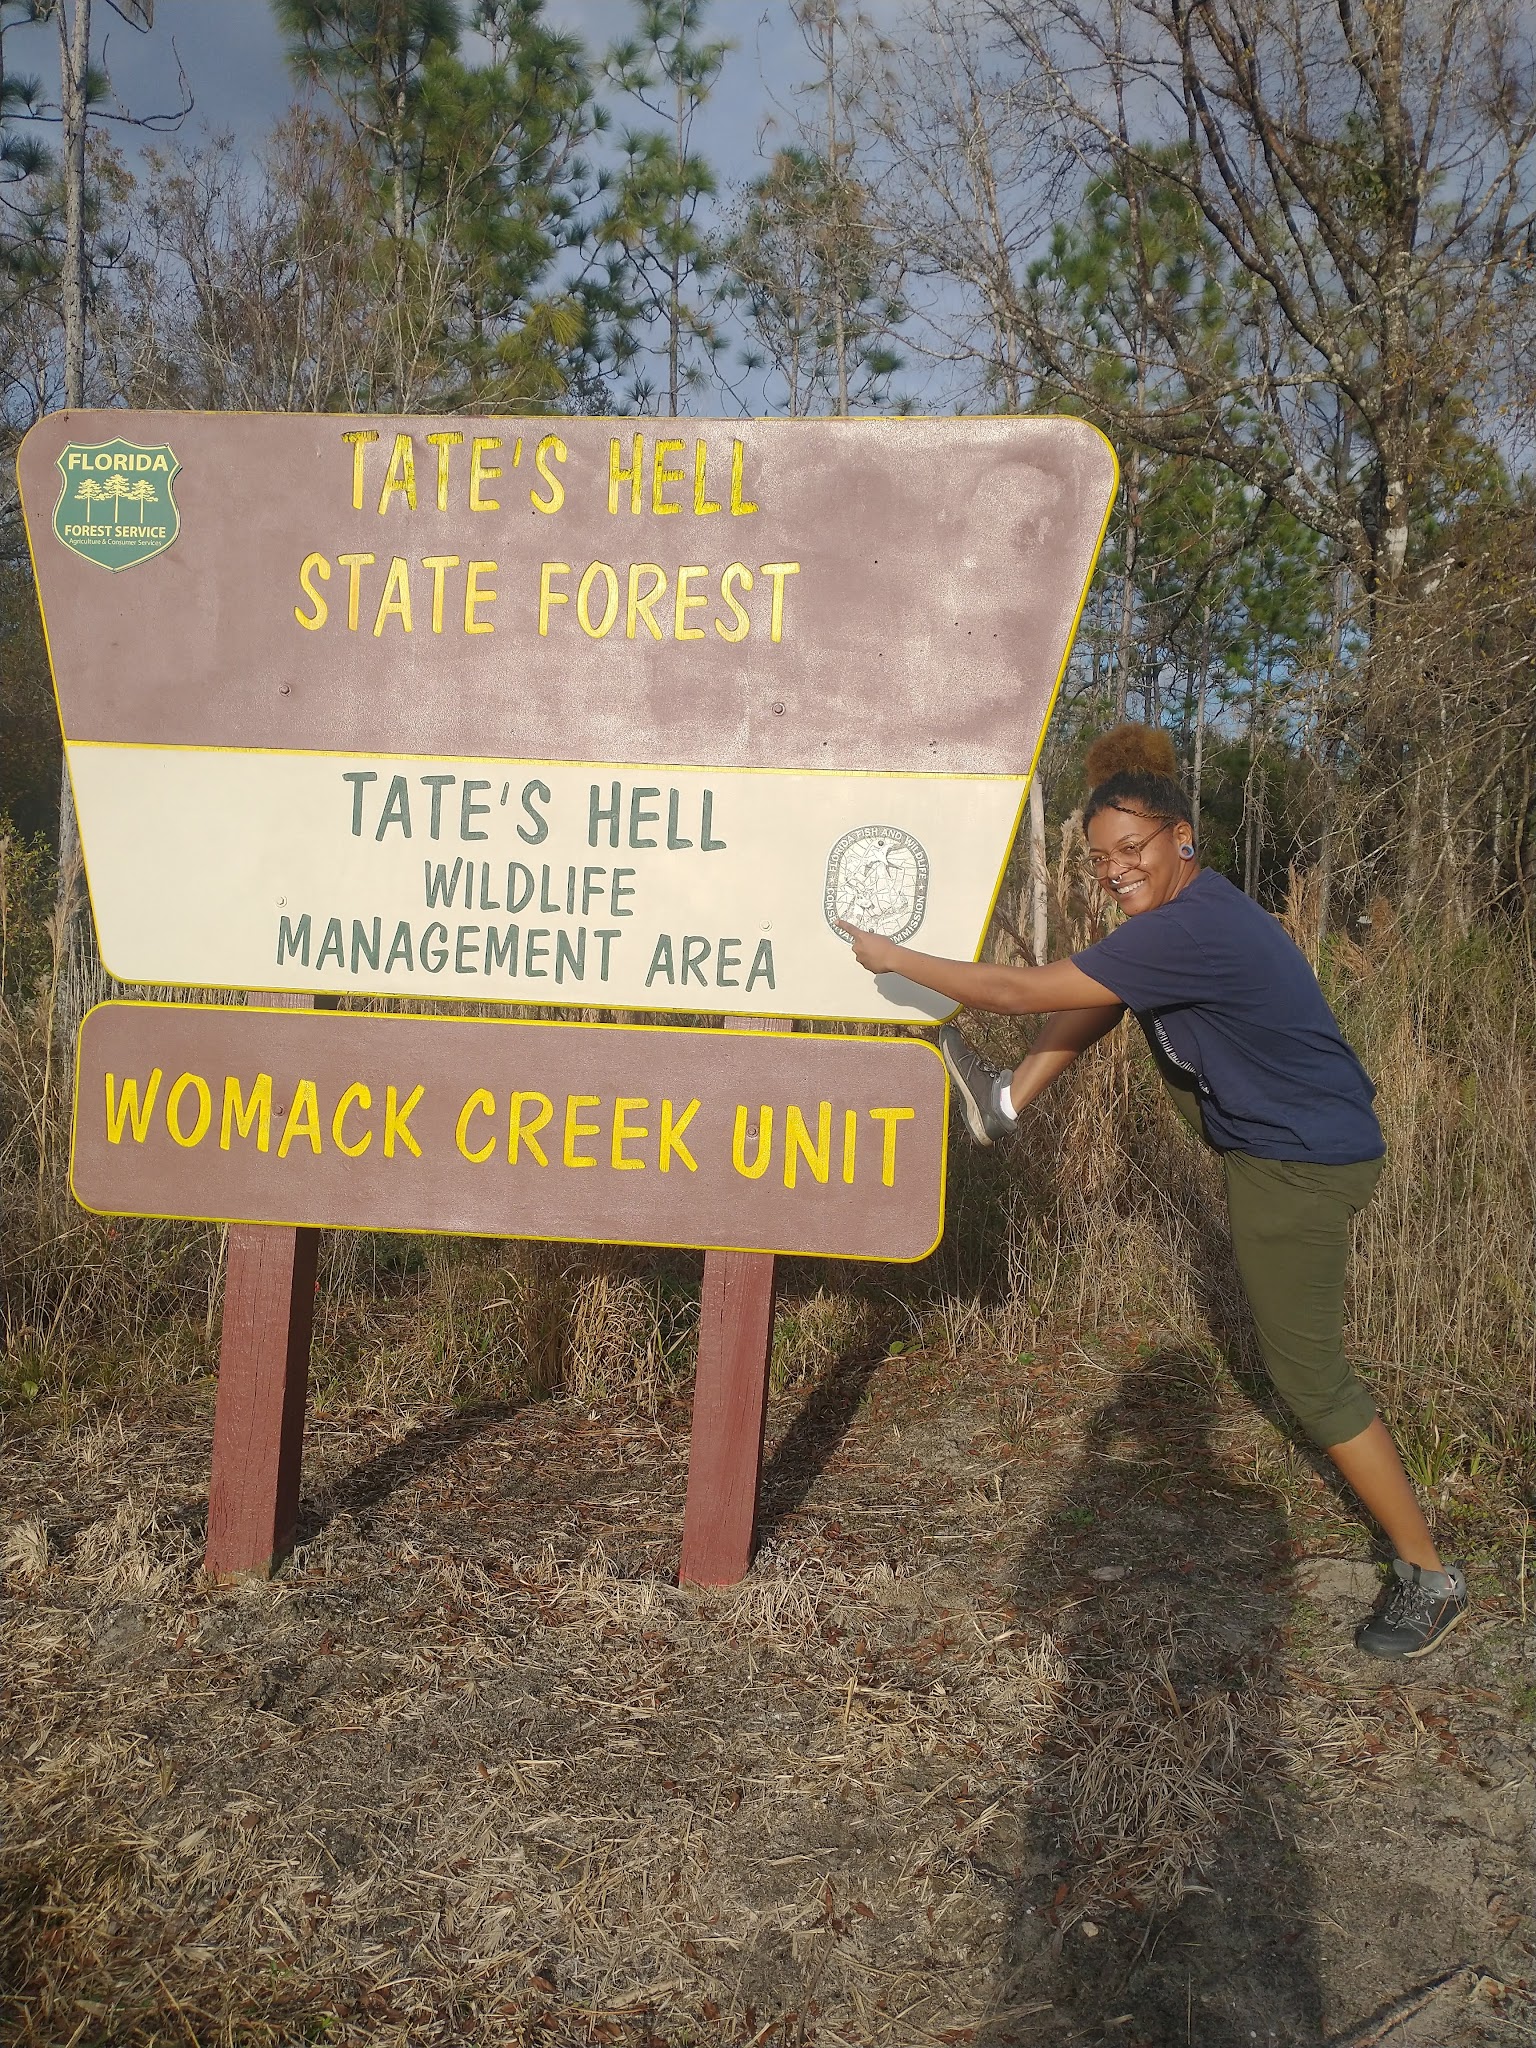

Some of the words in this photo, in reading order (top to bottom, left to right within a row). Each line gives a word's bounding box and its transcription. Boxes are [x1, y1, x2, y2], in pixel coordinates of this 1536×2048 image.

[68, 454, 168, 471] FLORIDA
[341, 429, 568, 515] TATE'S
[607, 432, 760, 517] HELL
[64, 524, 112, 537] FOREST
[114, 525, 167, 538] SERVICE
[69, 537, 101, 546] Agriculture
[107, 538, 137, 546] Consumer
[294, 551, 498, 638] STATE
[537, 559, 801, 643] FOREST
[342, 771, 552, 845] TATE'S
[588, 781, 727, 851] HELL
[424, 856, 636, 917] WILDLIFE
[829, 836, 855, 871] FLORIDA
[856, 827, 878, 839] FISH
[881, 828, 902, 841] AND
[905, 836, 927, 879] WILDLIFE
[276, 913, 622, 985] MANAGEMENT
[644, 933, 777, 992] AREA
[104, 1066, 426, 1160] WOMACK
[454, 1087, 702, 1174] CREEK
[731, 1100, 916, 1190] UNIT
